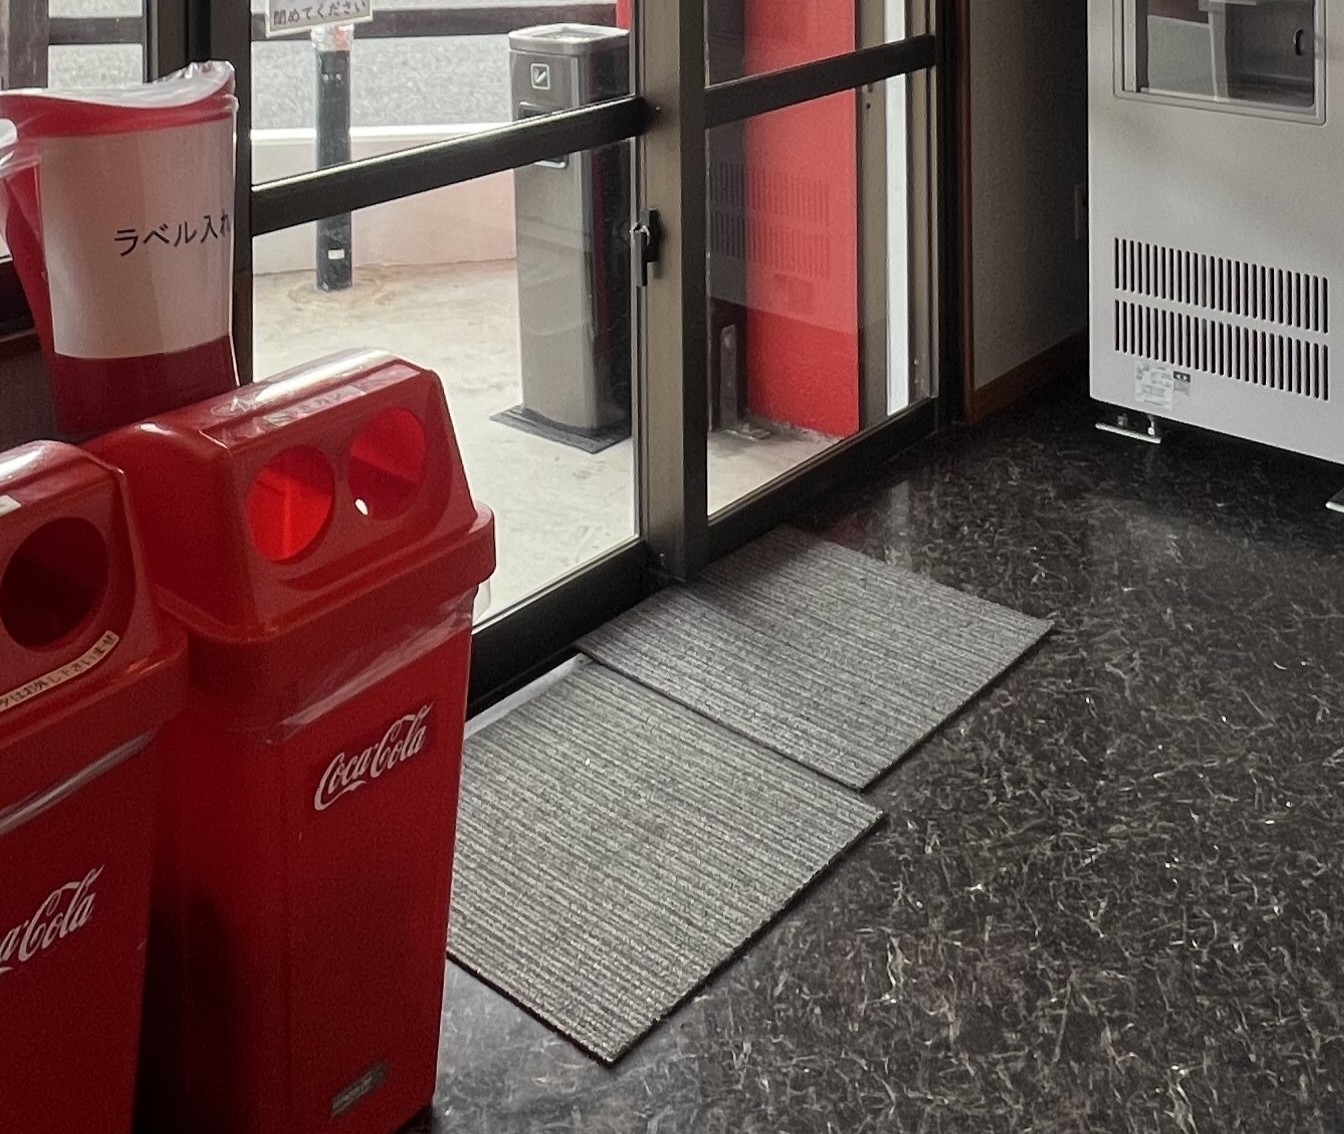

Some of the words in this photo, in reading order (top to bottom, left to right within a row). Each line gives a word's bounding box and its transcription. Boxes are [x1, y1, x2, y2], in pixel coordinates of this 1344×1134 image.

[113, 213, 232, 257] ラベル入れ
[313, 703, 435, 811] Coca-Cola
